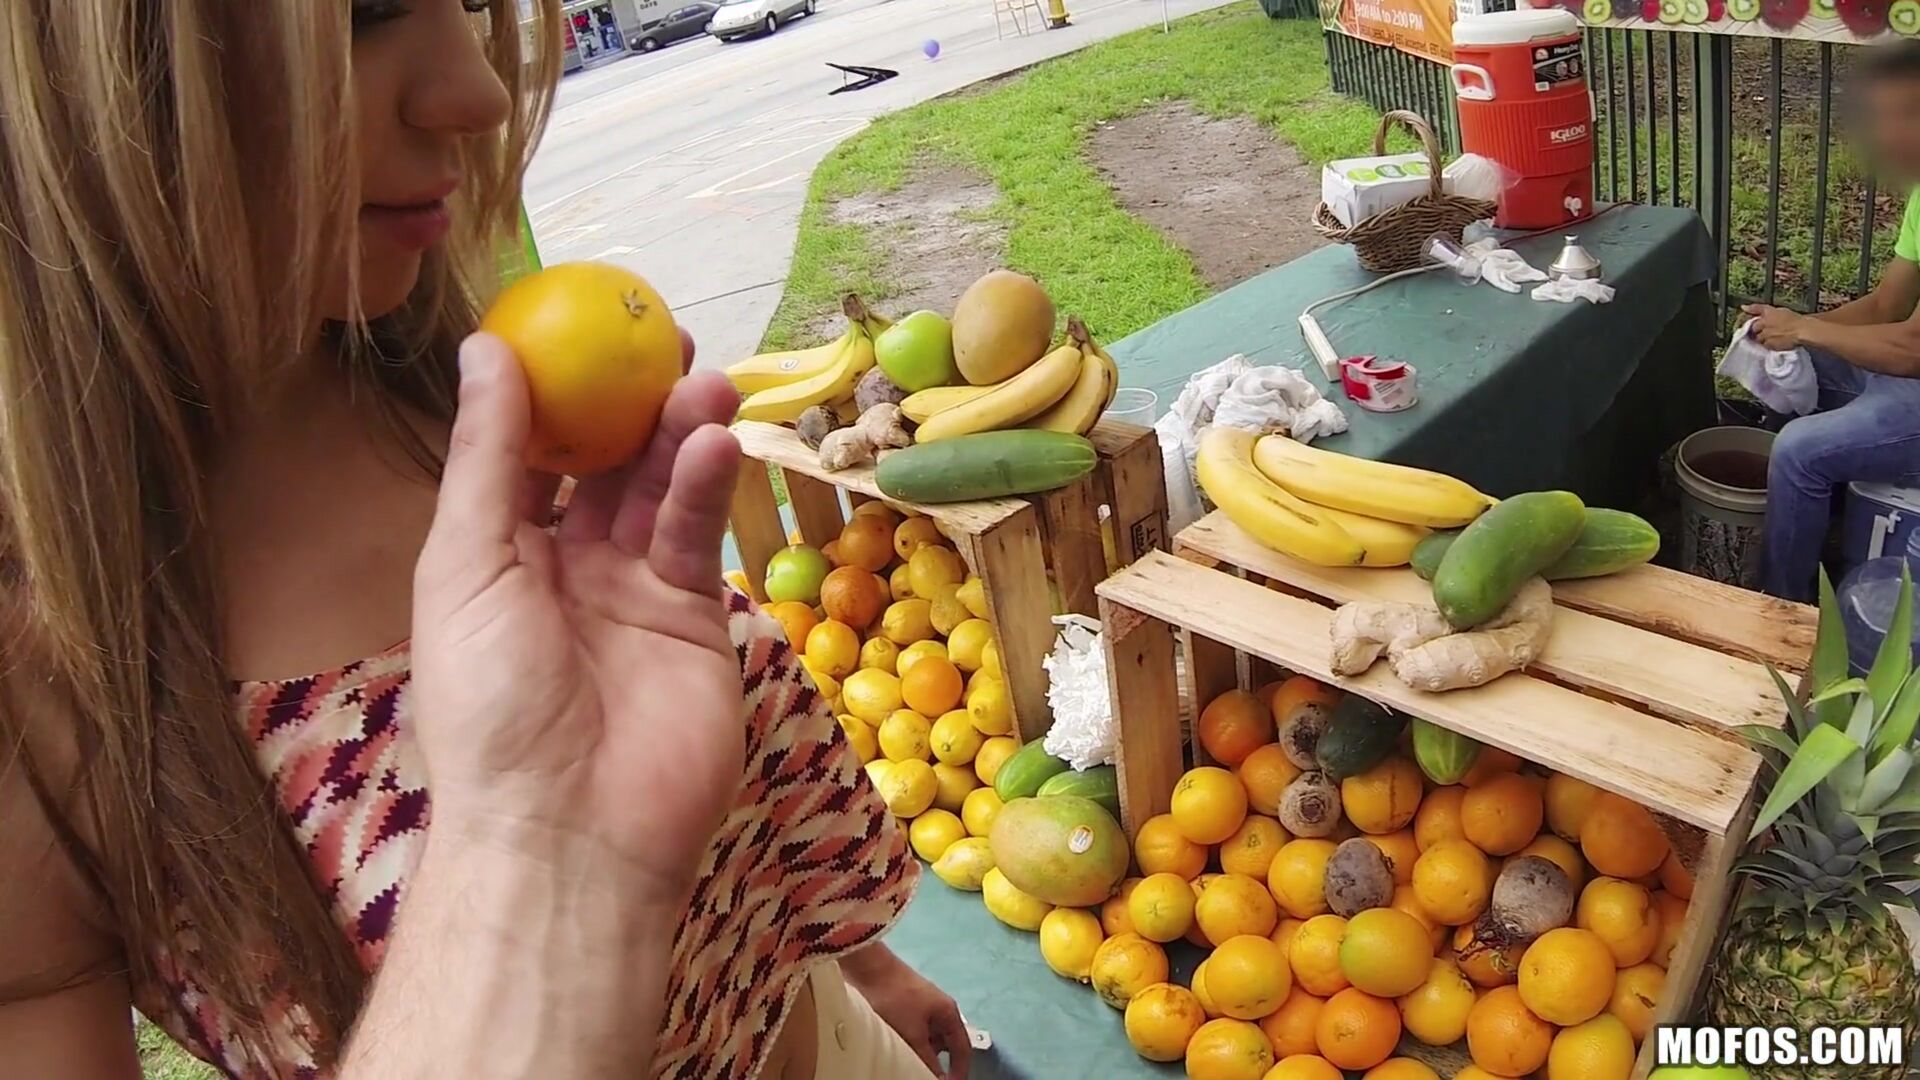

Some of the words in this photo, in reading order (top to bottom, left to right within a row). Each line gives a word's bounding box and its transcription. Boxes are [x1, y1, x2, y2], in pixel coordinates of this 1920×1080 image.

[1382, 9, 1391, 25] to
[1391, 9, 1409, 28] 2:00
[1409, 12, 1425, 32] PM
[1550, 124, 1586, 142] IGLOO
